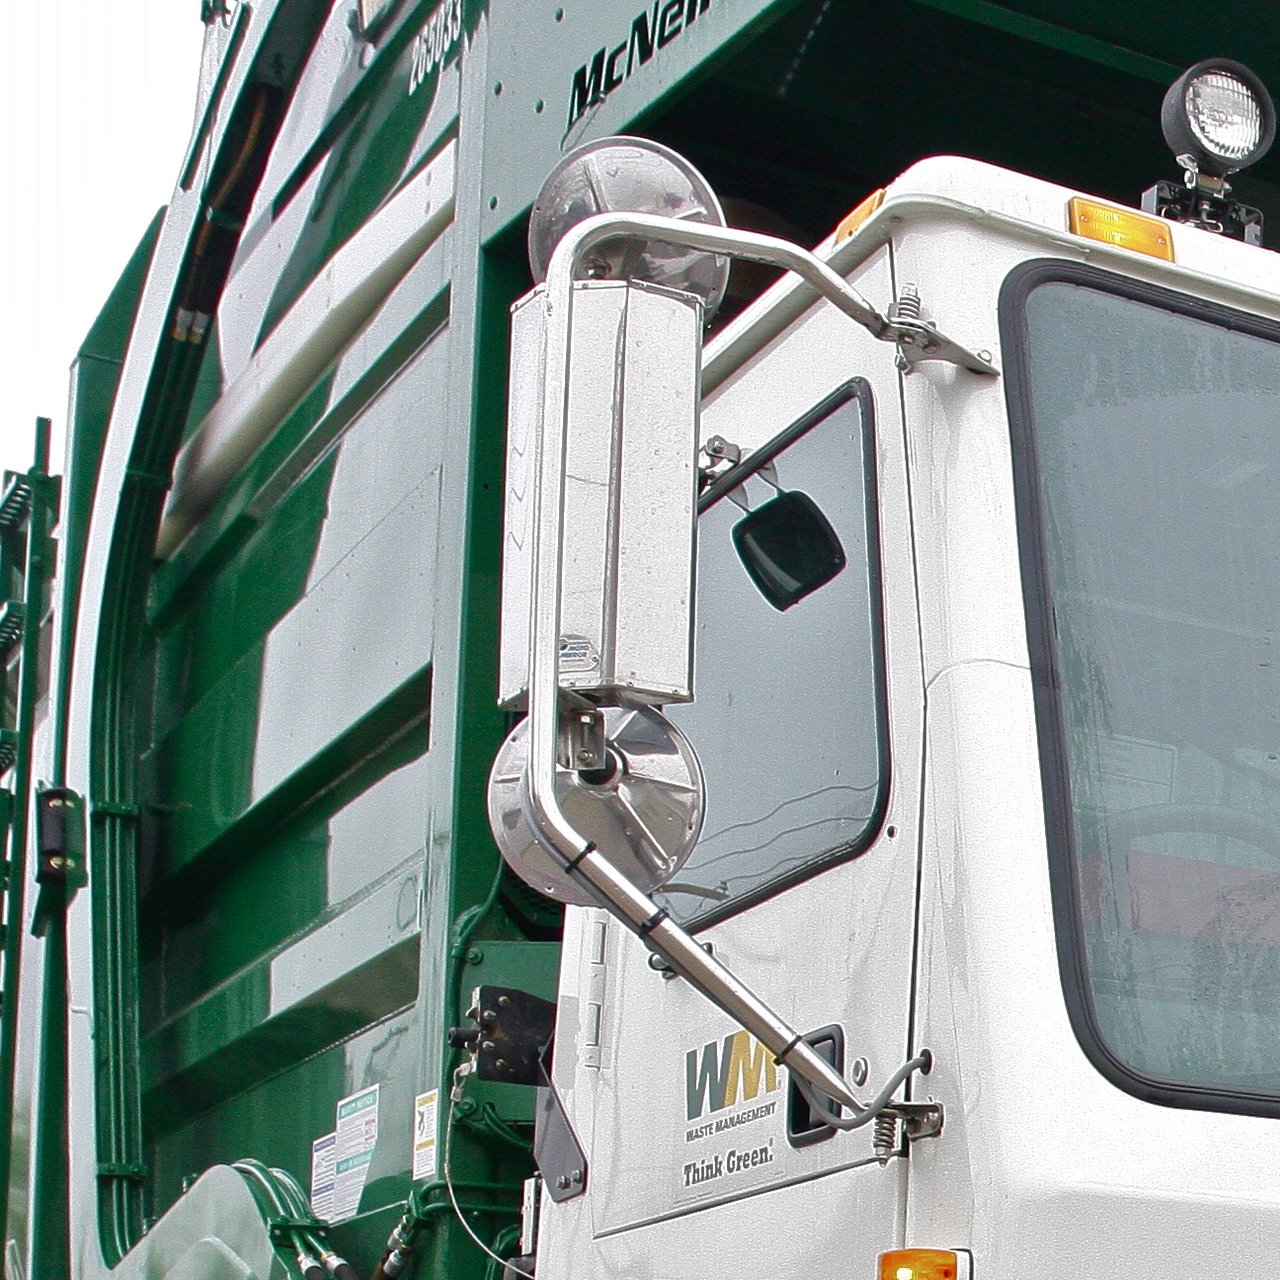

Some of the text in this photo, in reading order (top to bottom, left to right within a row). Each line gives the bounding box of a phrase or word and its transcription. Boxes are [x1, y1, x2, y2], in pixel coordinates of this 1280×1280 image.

[566, 0, 711, 129] McNei
[686, 1101, 777, 1143] WASTE MANAGEMENT
[683, 1155, 724, 1187] Think
